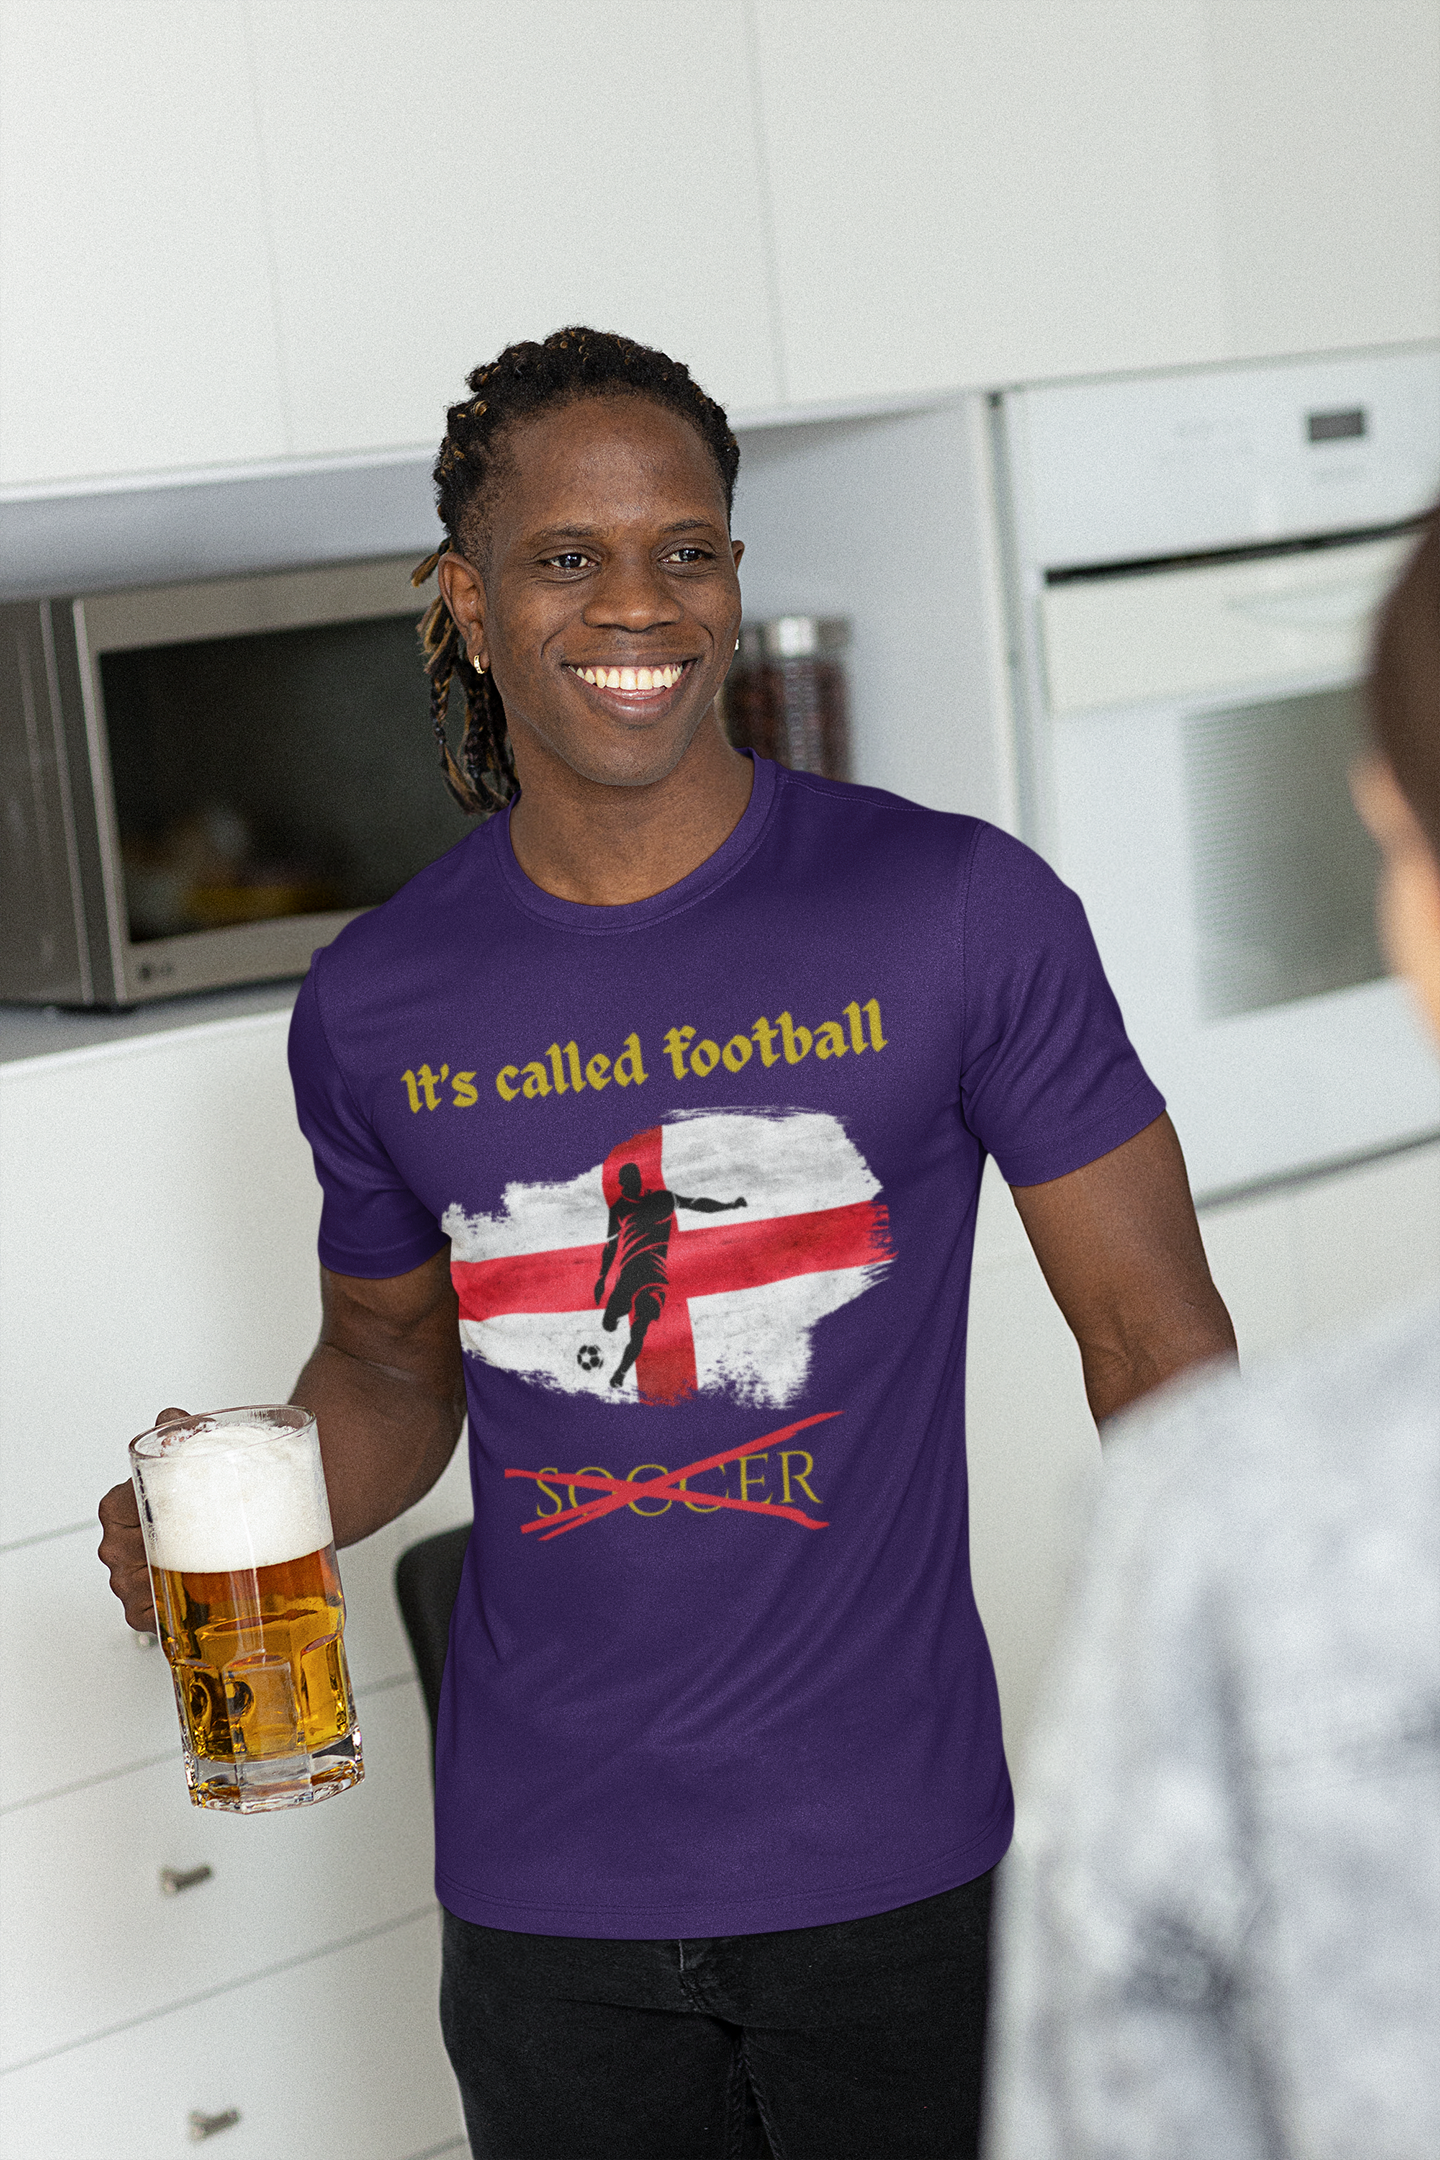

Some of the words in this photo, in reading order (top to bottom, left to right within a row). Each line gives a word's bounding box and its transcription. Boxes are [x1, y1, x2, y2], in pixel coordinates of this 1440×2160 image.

[400, 1063, 479, 1114] It's
[495, 1032, 649, 1102] called
[663, 998, 889, 1080] football
[536, 1450, 823, 1518] SOCCER
